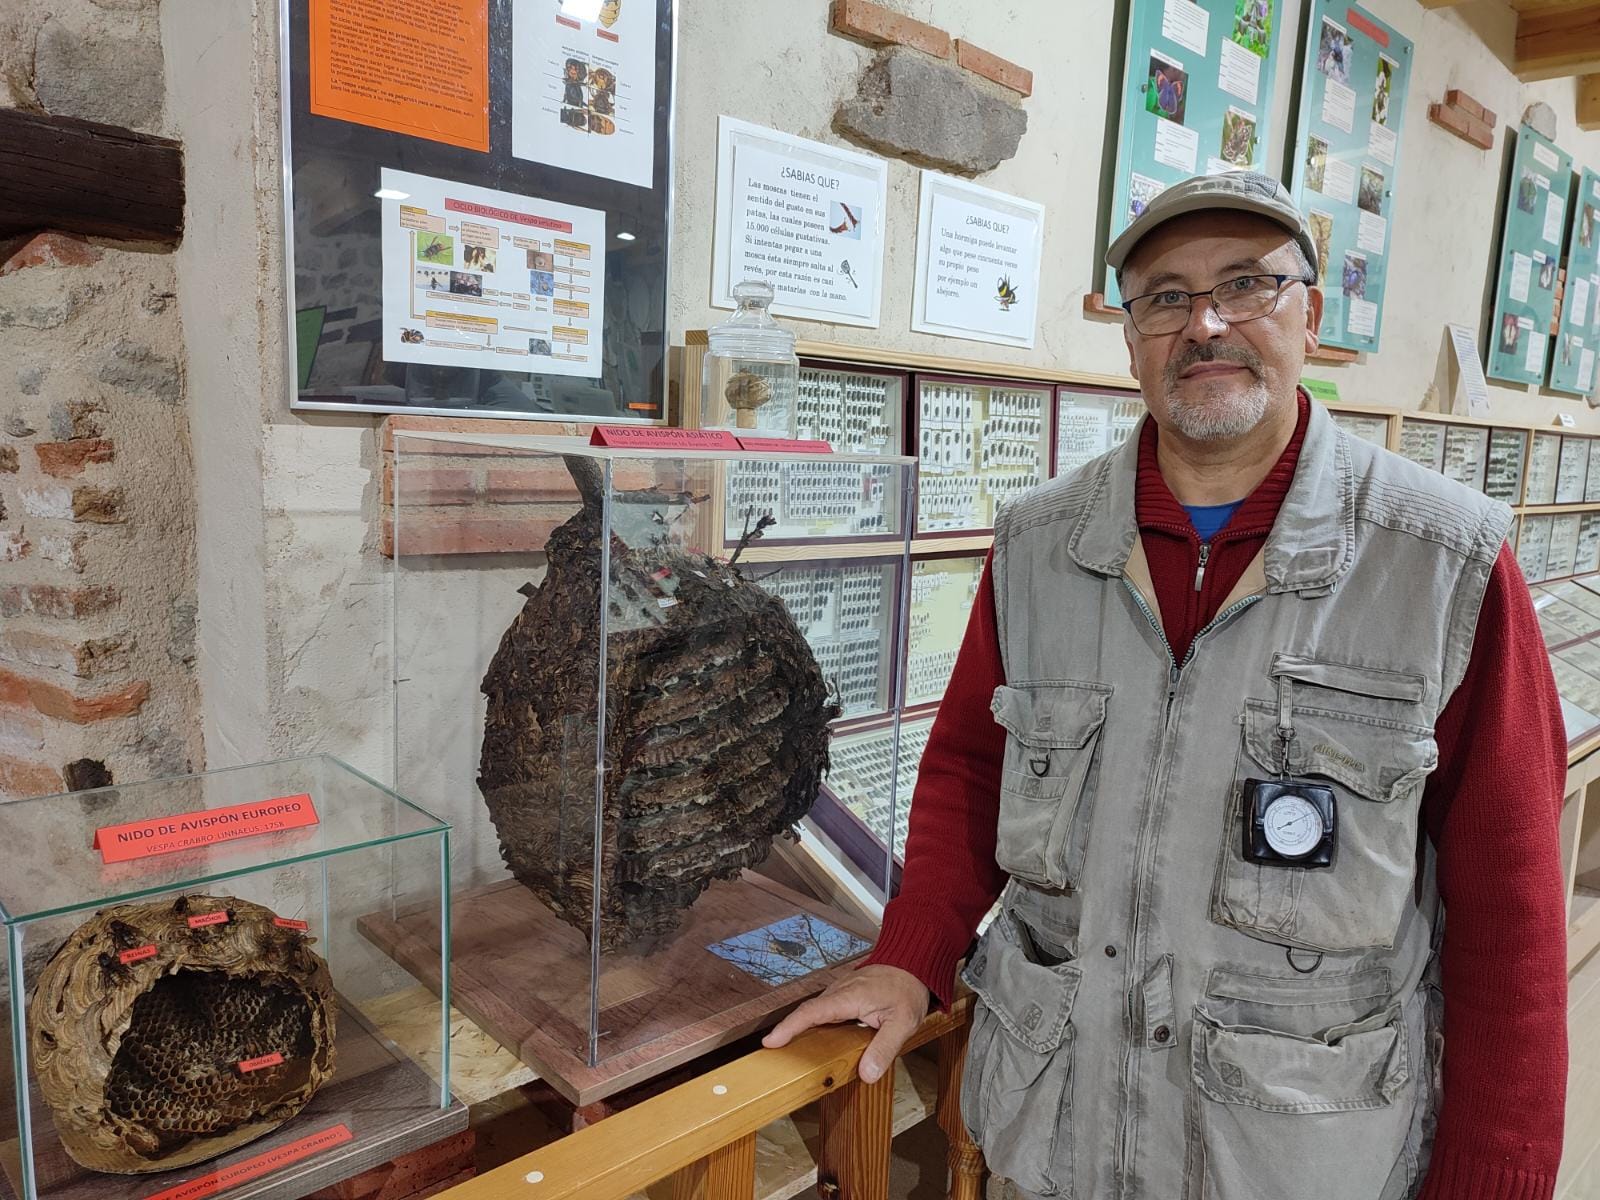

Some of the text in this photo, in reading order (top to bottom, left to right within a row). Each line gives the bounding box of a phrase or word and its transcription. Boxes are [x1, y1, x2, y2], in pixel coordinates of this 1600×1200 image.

[781, 167, 840, 190] ¿SABIAS QUE?
[748, 178, 818, 202] Las moscas tienen el
[747, 194, 773, 206] sentido
[774, 198, 784, 208] del
[786, 203, 804, 212] gusto
[770, 211, 780, 220] las
[782, 216, 802, 226] cuales
[966, 216, 1010, 234] ¿SABIAS QUE?
[746, 221, 769, 232] 15.000
[770, 226, 795, 238] células
[942, 228, 954, 239] Una
[745, 234, 752, 244] Si
[754, 236, 783, 250] intentas
[784, 244, 803, 254] pegar
[744, 250, 766, 260] mosca
[783, 256, 810, 268] siempre
[766, 268, 778, 276] por
[778, 270, 792, 279] esta
[821, 289, 828, 298] la
[606, 429, 630, 437] NIDO
[646, 430, 684, 438] AVISPÓN
[686, 430, 723, 440] ASIÁTICO
[118, 802, 302, 843] NIDO DE AVISPÓN EUROPEO
[146, 842, 176, 854] VESPA
[178, 834, 214, 848] CRABRO
[176, 1179, 219, 1198] AVISPÓN
[220, 1160, 266, 1182] EUROPEO
